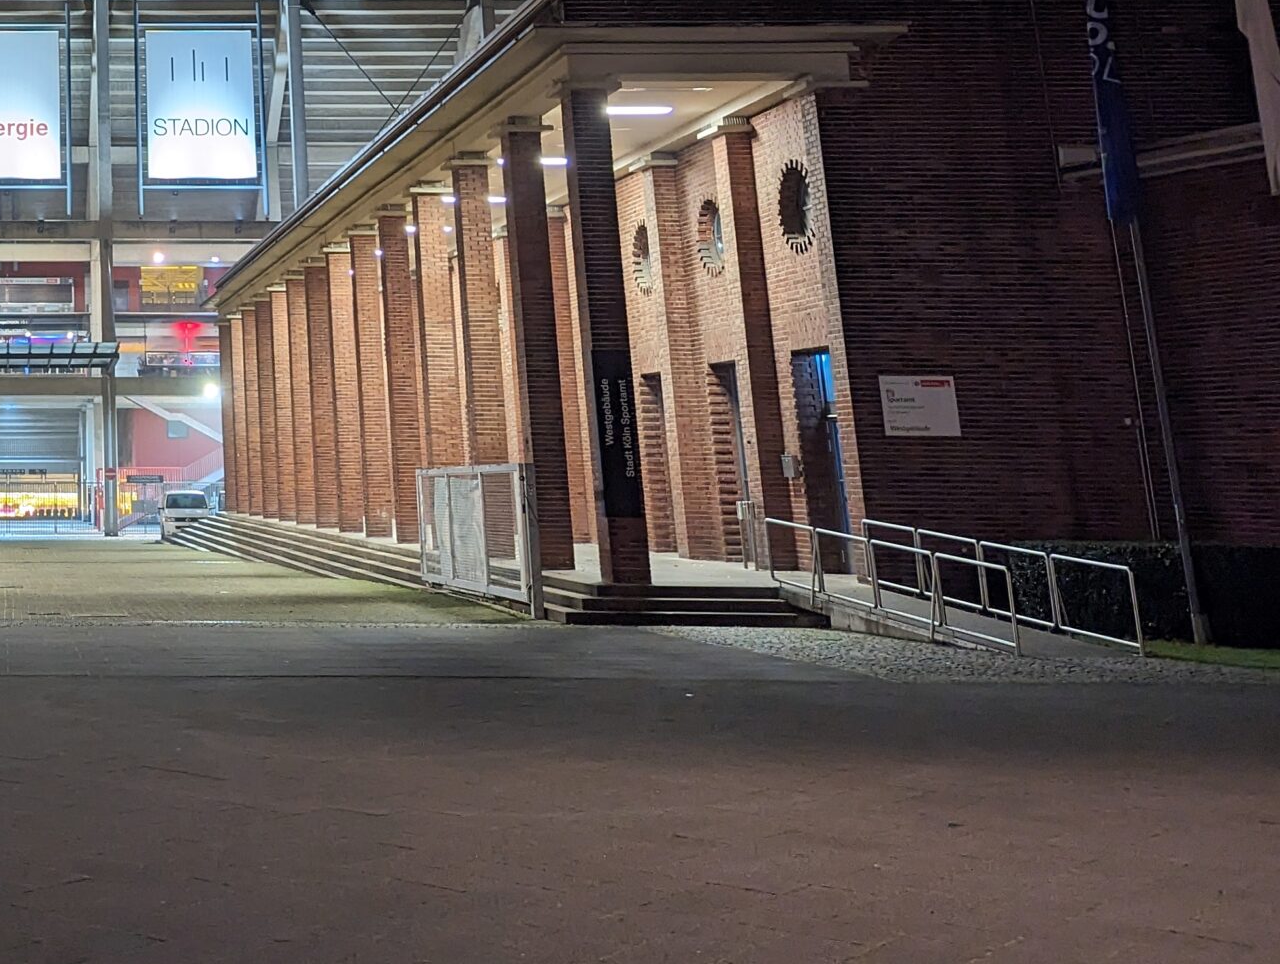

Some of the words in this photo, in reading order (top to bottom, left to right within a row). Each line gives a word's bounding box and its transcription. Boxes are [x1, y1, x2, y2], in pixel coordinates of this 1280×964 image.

[153, 118, 249, 138] STADION
[601, 378, 614, 446] Westgebäude
[618, 379, 631, 425] Sportamt
[623, 427, 632, 448] Köln
[625, 450, 636, 478] Stadt
